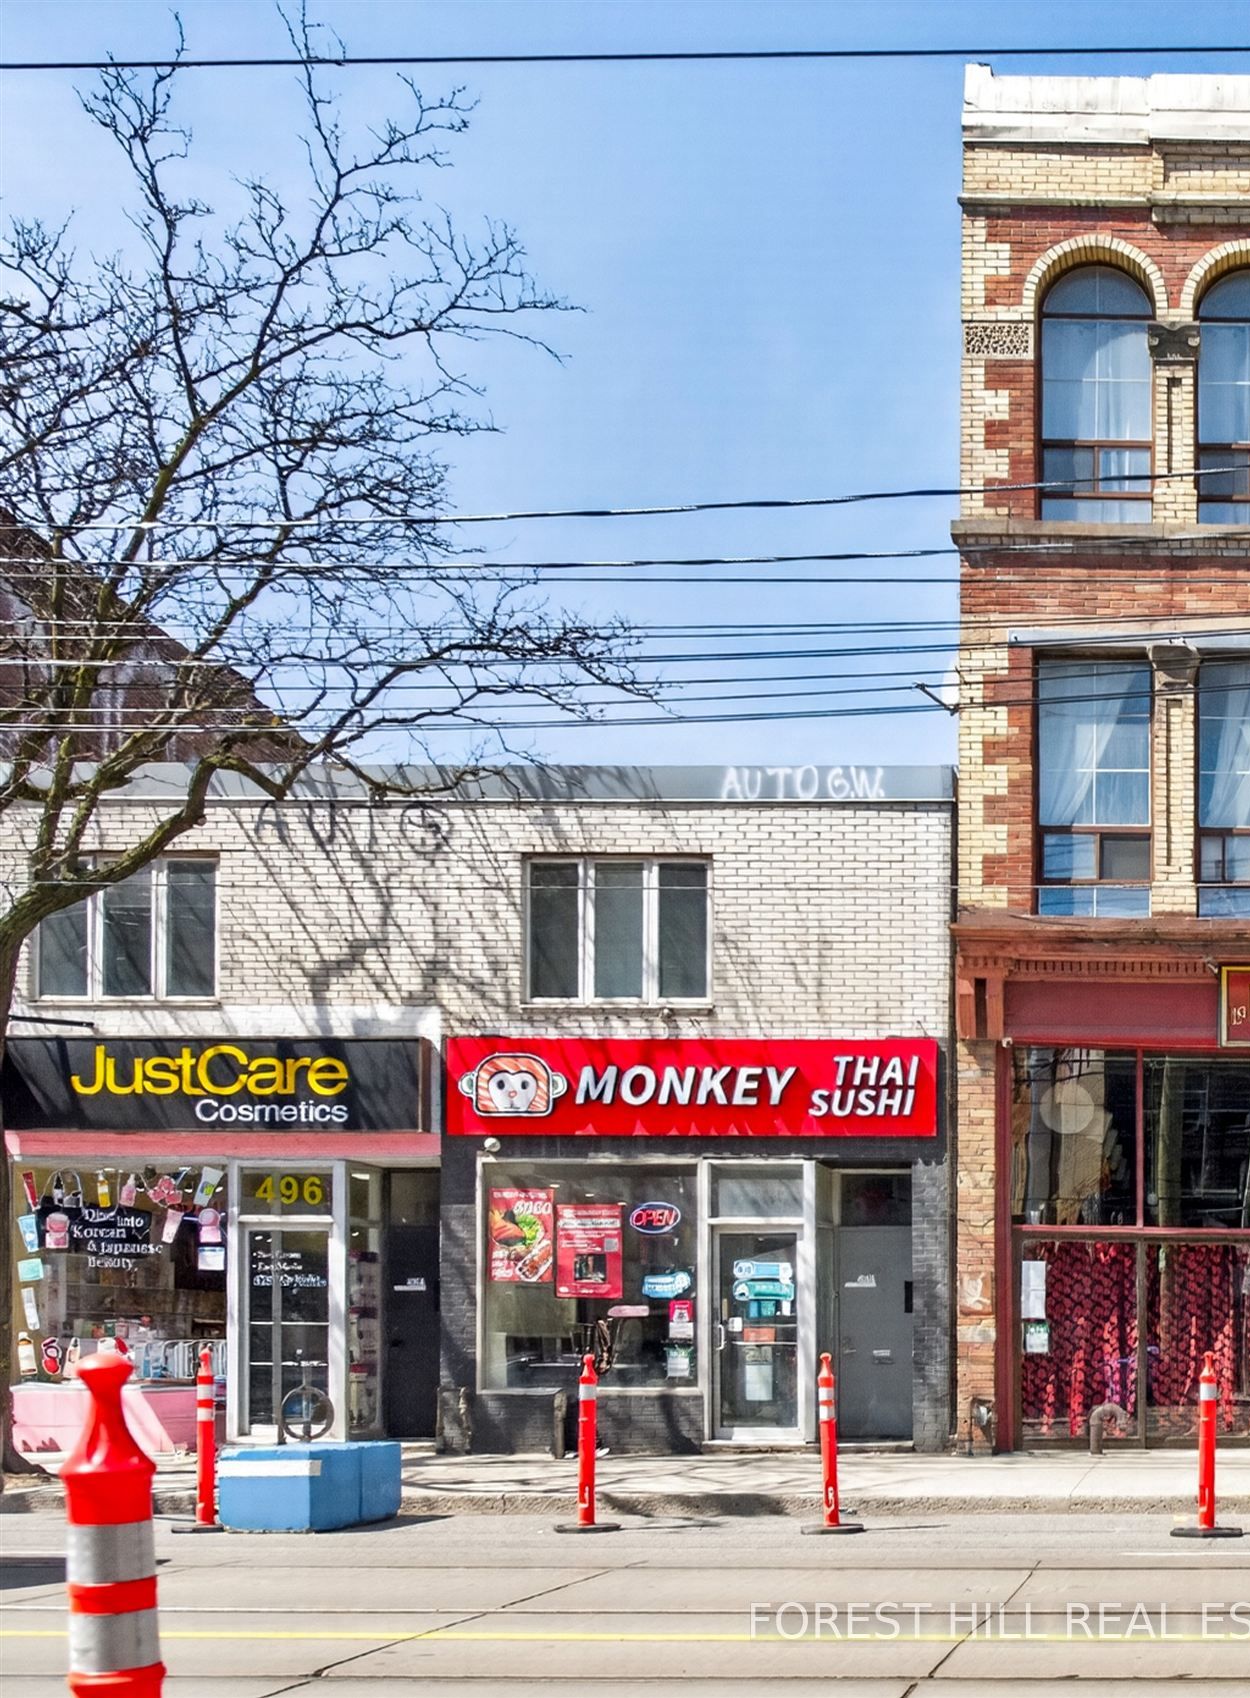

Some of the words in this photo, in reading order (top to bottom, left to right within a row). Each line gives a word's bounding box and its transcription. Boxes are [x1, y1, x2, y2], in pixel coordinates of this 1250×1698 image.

[721, 765, 819, 799] AUTO
[71, 1045, 348, 1096] JustCare
[575, 1065, 797, 1105] MONKEY
[832, 1055, 919, 1087] THAI
[195, 1099, 348, 1123] Cosmetics
[808, 1088, 916, 1117] SUSHI
[255, 1175, 323, 1205] 496
[633, 1208, 677, 1227] OPEN
